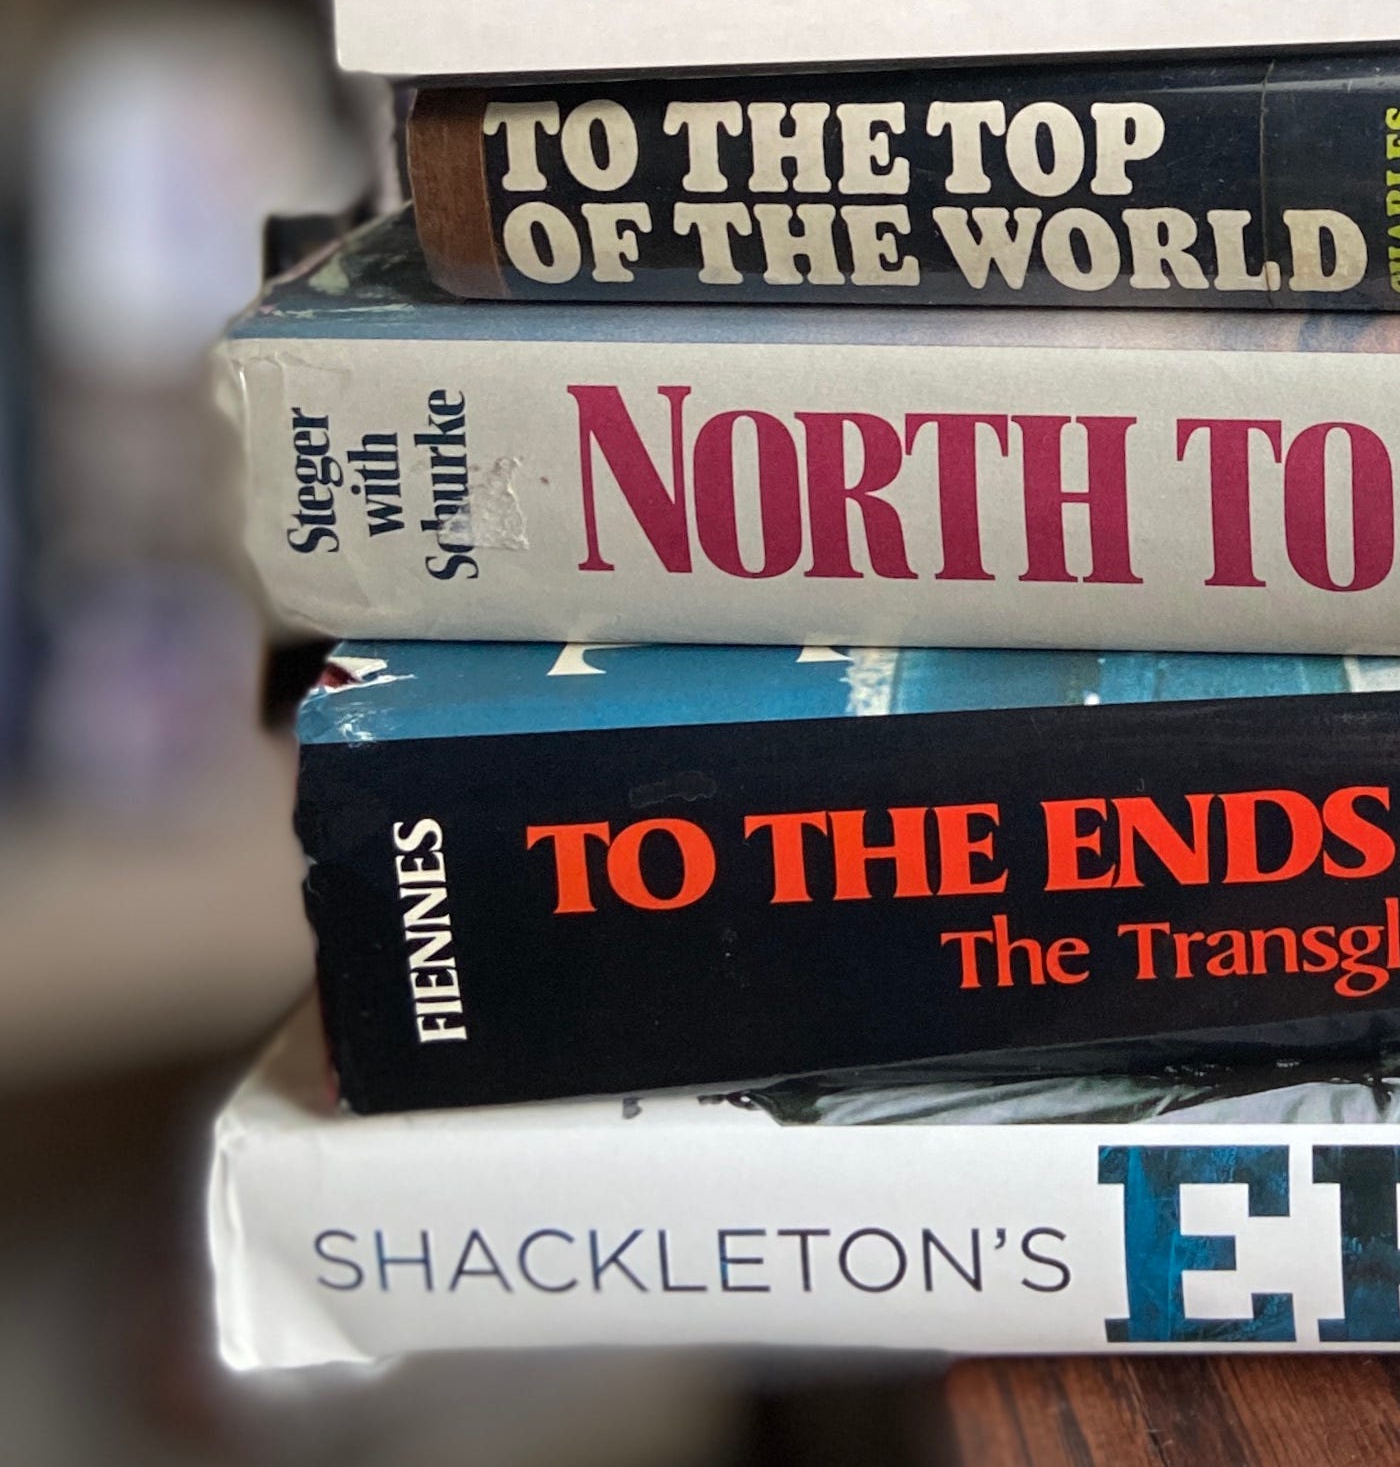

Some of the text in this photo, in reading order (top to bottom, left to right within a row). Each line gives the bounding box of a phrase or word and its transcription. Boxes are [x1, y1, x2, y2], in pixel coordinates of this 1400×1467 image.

[479, 100, 1165, 197] TO THE TOP
[503, 202, 1367, 291] OF THE WORLD
[287, 407, 343, 553] Steger
[347, 433, 404, 537] with
[567, 385, 1144, 584] NORTH
[1177, 419, 1394, 592] TO
[526, 818, 716, 913] TO
[744, 803, 1008, 903] THE
[1041, 786, 1396, 891] ENDS
[393, 817, 467, 1042] FIENNES
[941, 914, 1089, 988] The
